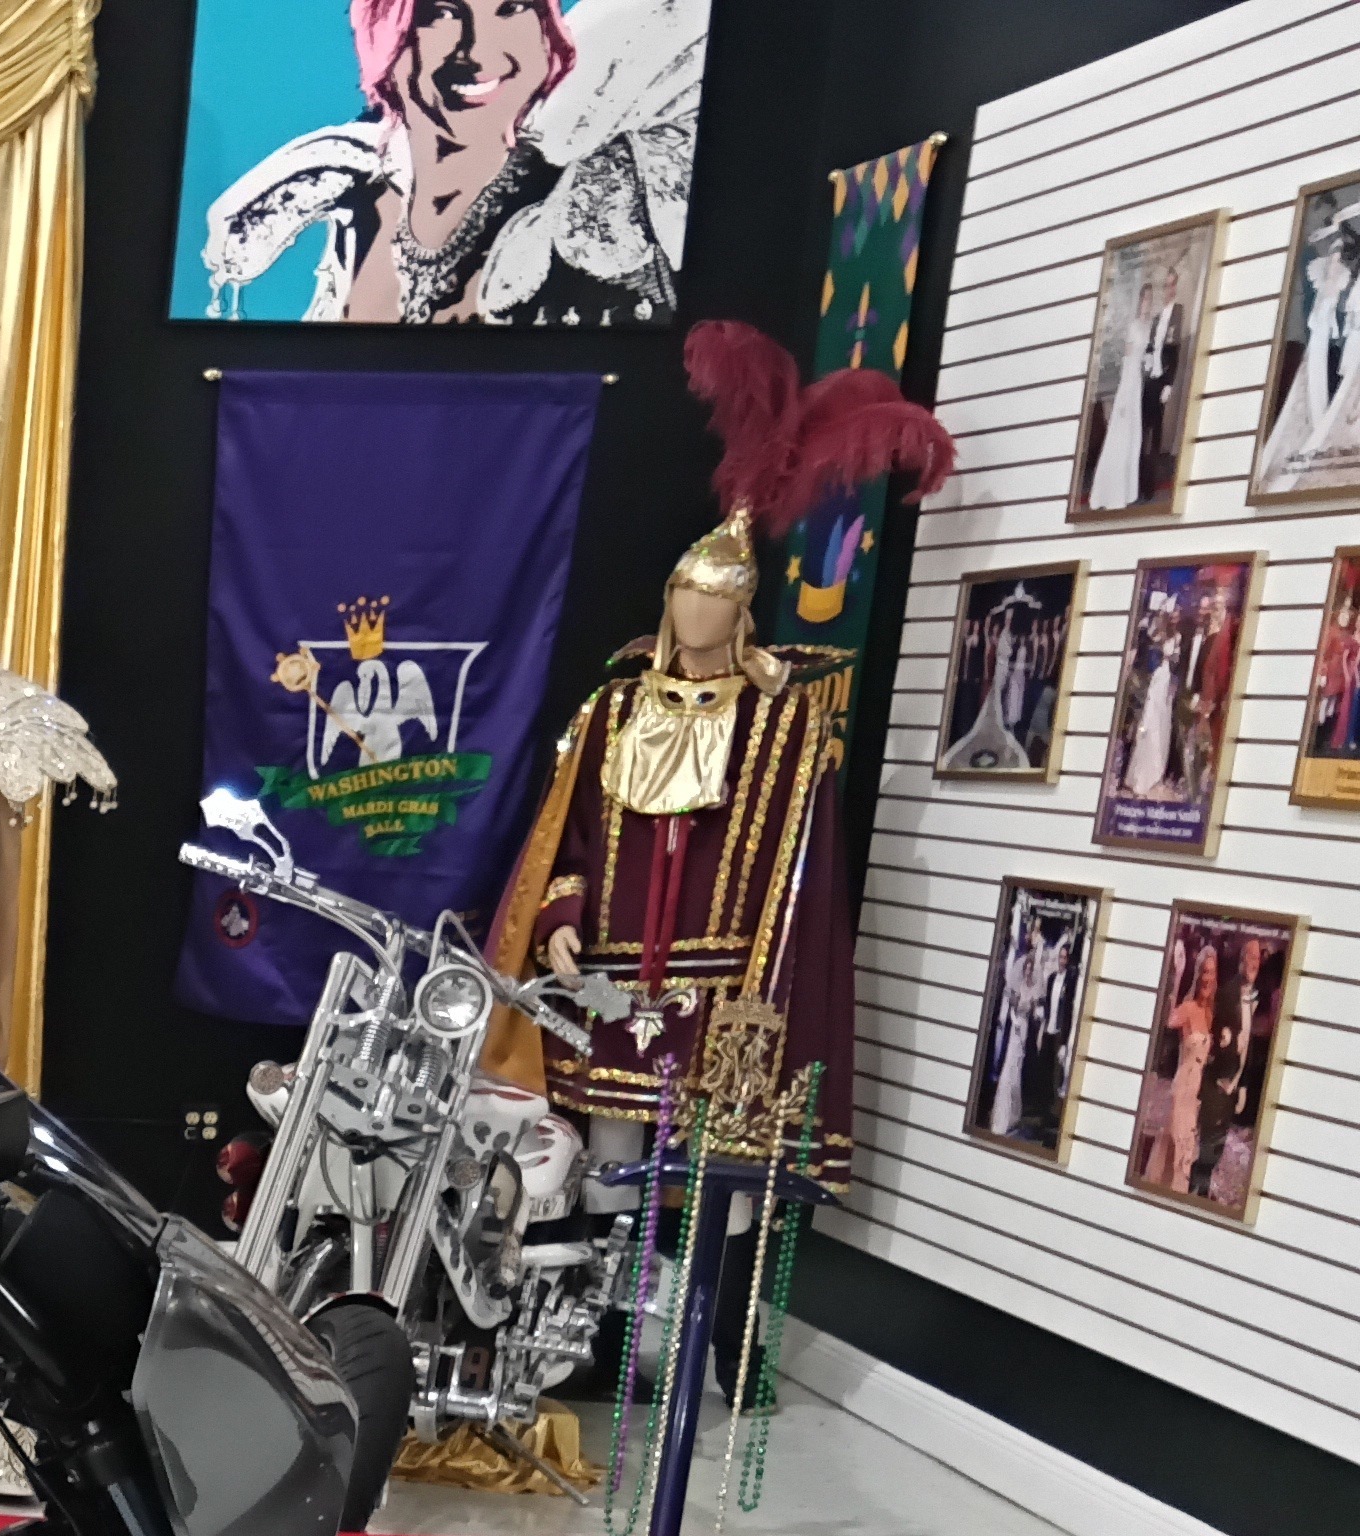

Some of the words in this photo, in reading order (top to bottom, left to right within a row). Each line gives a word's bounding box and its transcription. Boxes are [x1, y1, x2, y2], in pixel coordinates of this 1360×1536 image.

[307, 758, 456, 801] WASHINGTON
[342, 801, 394, 819] MARDI
[397, 801, 438, 815] GRAS
[364, 819, 405, 838] BALL
